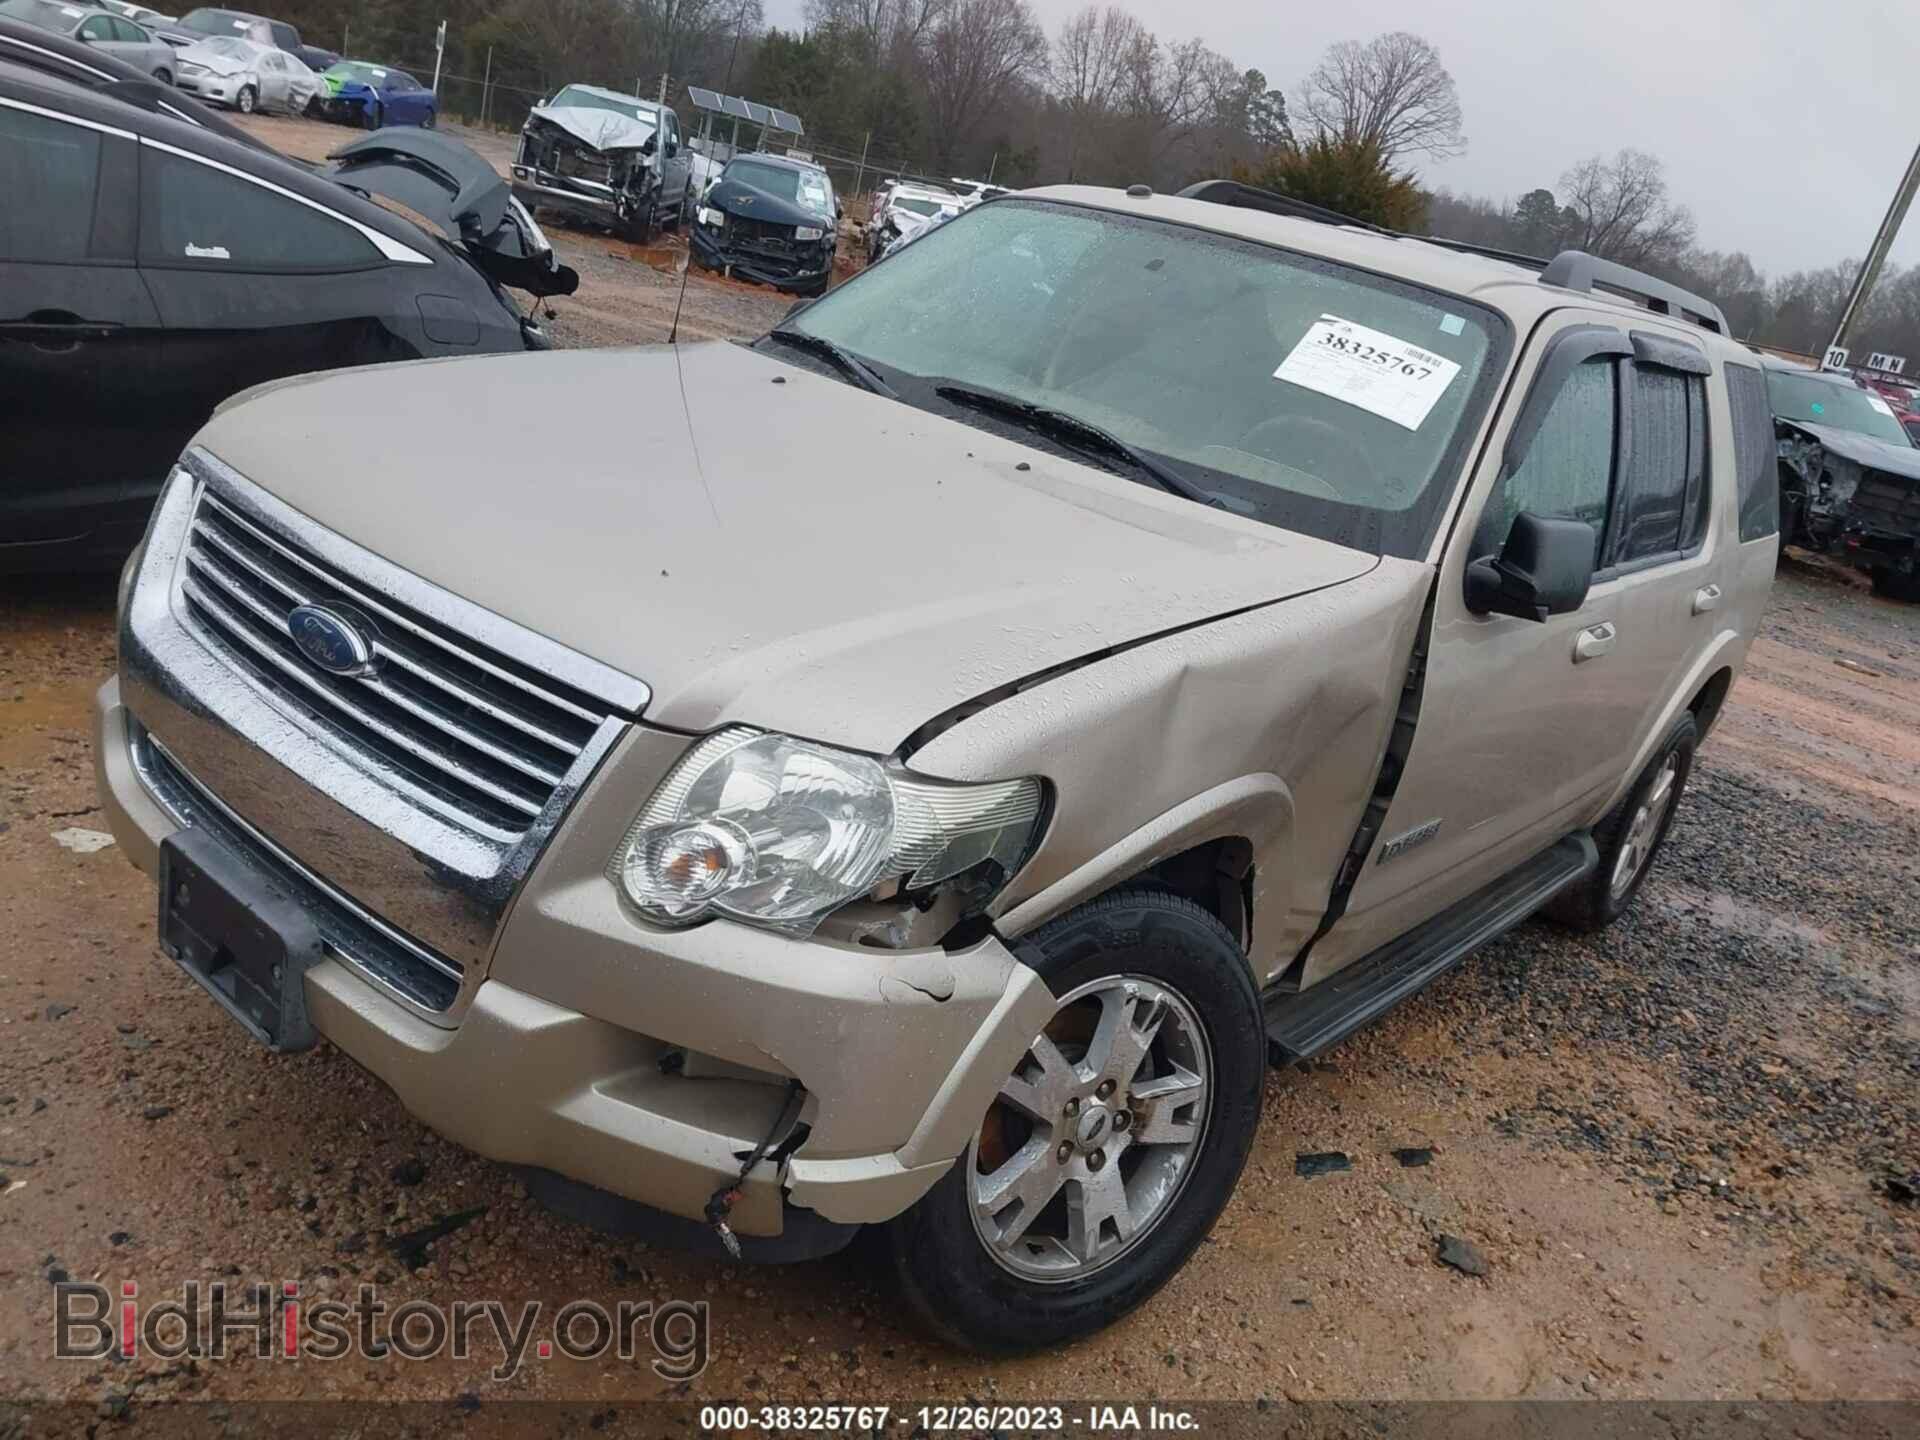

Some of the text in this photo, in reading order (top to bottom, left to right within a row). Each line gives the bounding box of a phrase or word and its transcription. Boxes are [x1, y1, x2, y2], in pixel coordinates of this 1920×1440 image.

[1318, 332, 1432, 381] 38325767
[1828, 350, 1845, 367] 10
[1871, 355, 1901, 371] M N
